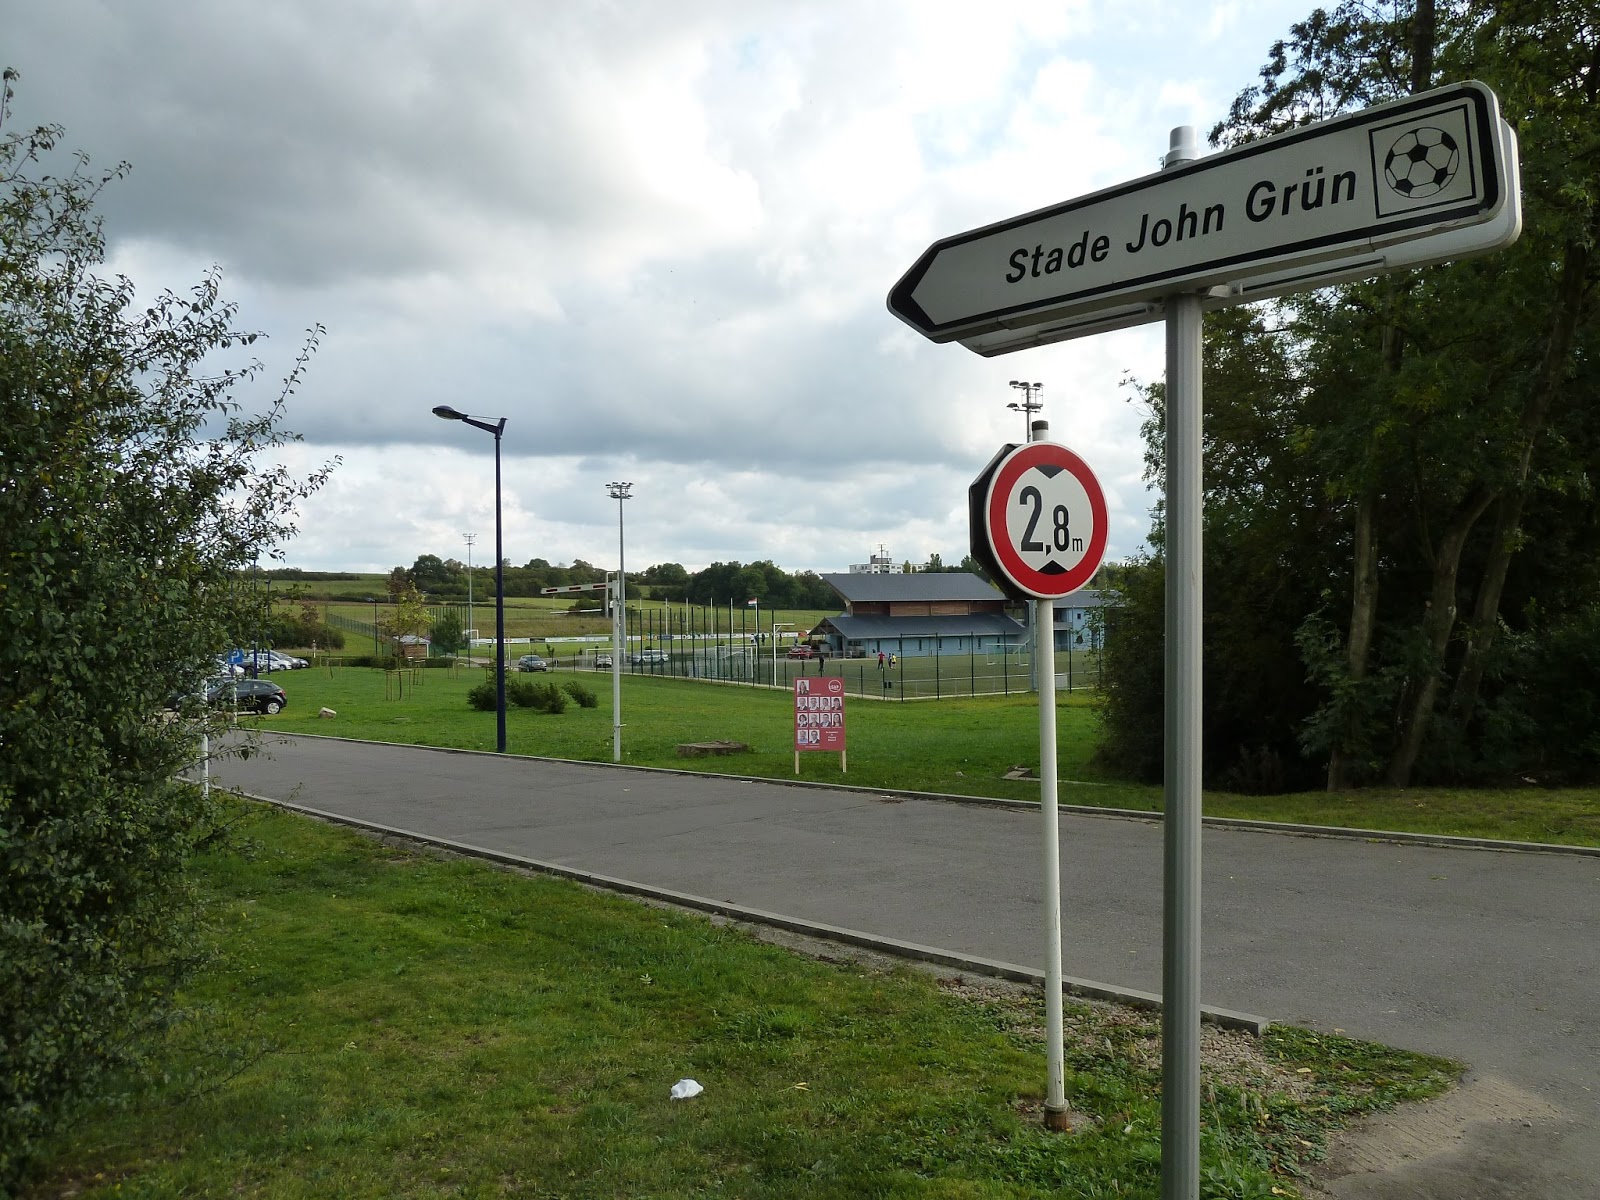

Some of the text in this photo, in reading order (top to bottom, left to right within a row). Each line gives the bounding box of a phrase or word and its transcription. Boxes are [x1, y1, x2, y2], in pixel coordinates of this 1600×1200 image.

[1006, 166, 1356, 283] Stade John Grün
